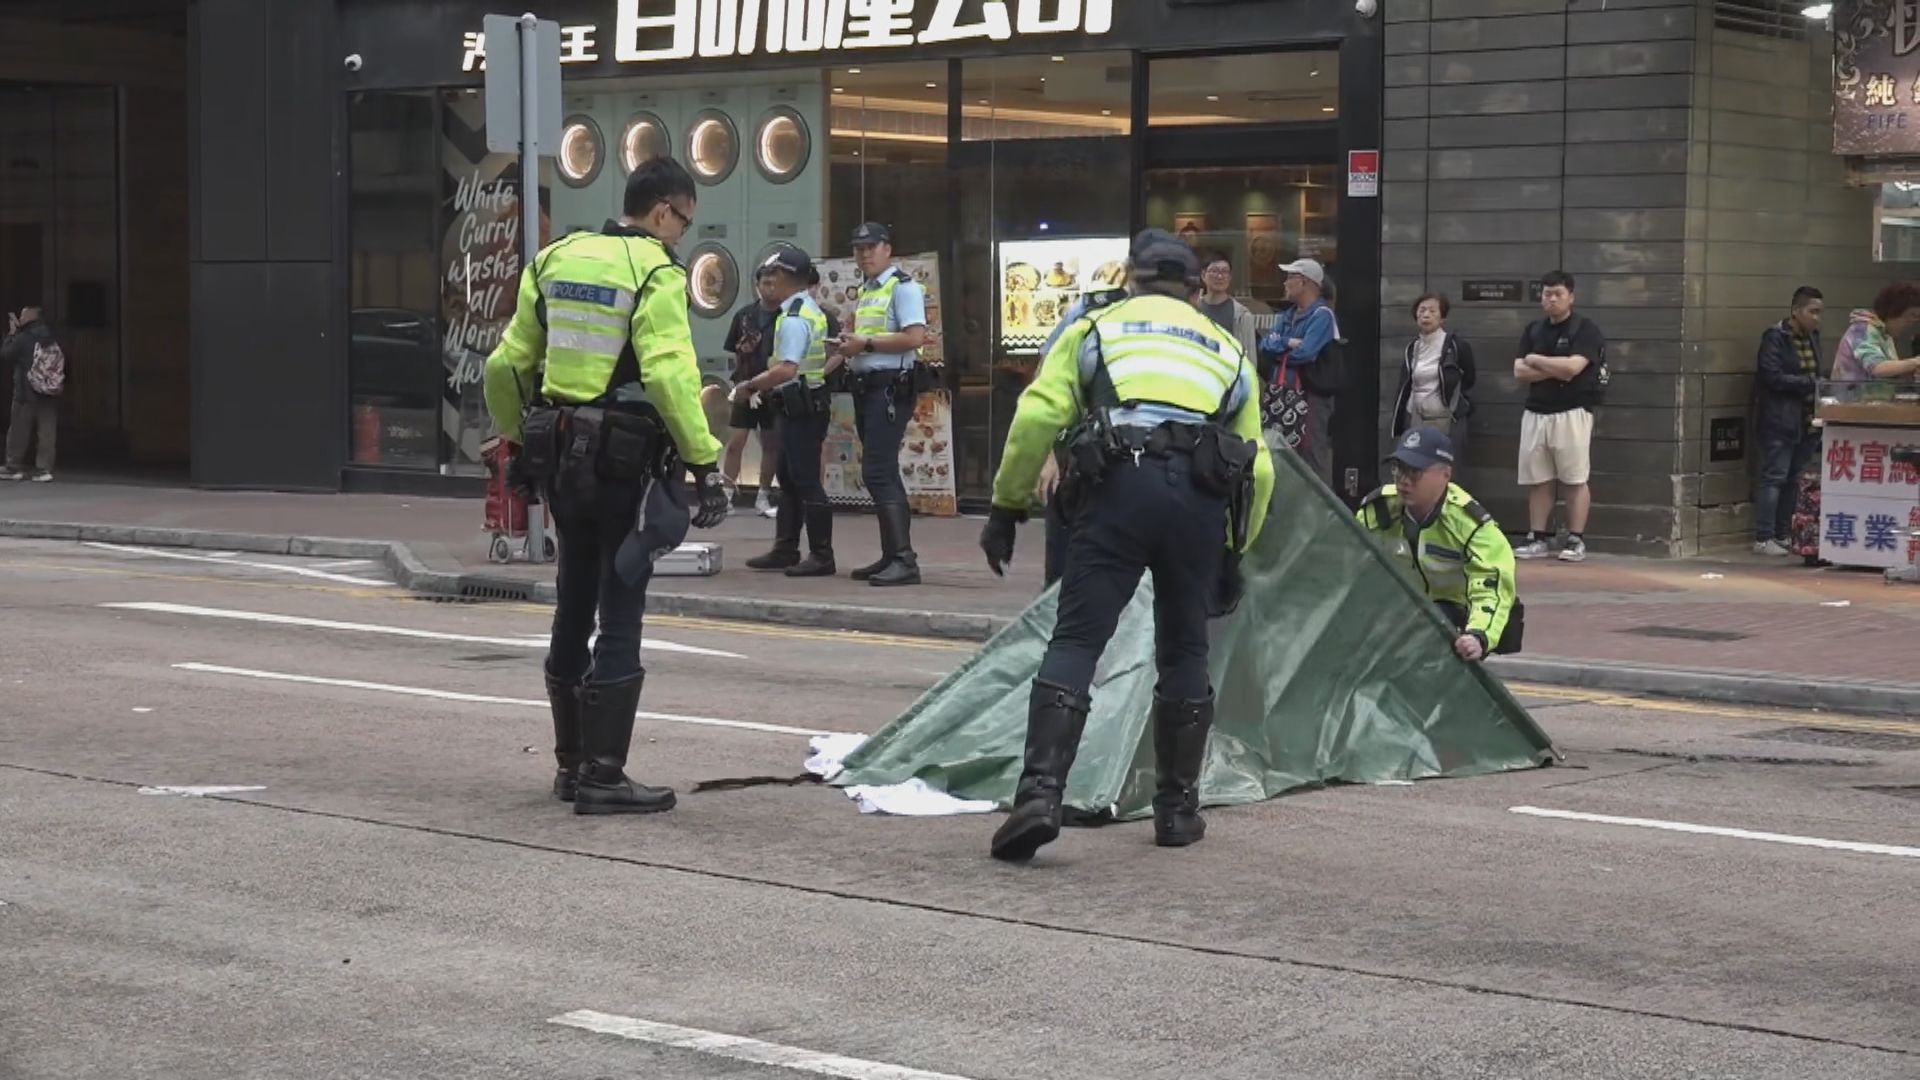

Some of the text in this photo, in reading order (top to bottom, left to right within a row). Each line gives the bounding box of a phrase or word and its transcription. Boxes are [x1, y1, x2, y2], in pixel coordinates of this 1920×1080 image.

[1865, 73, 1920, 106] 純
[454, 169, 514, 213] White
[459, 212, 519, 254] Curry
[470, 283, 503, 319] all
[552, 283, 597, 300] POLICE
[1825, 511, 1898, 551] 專業
